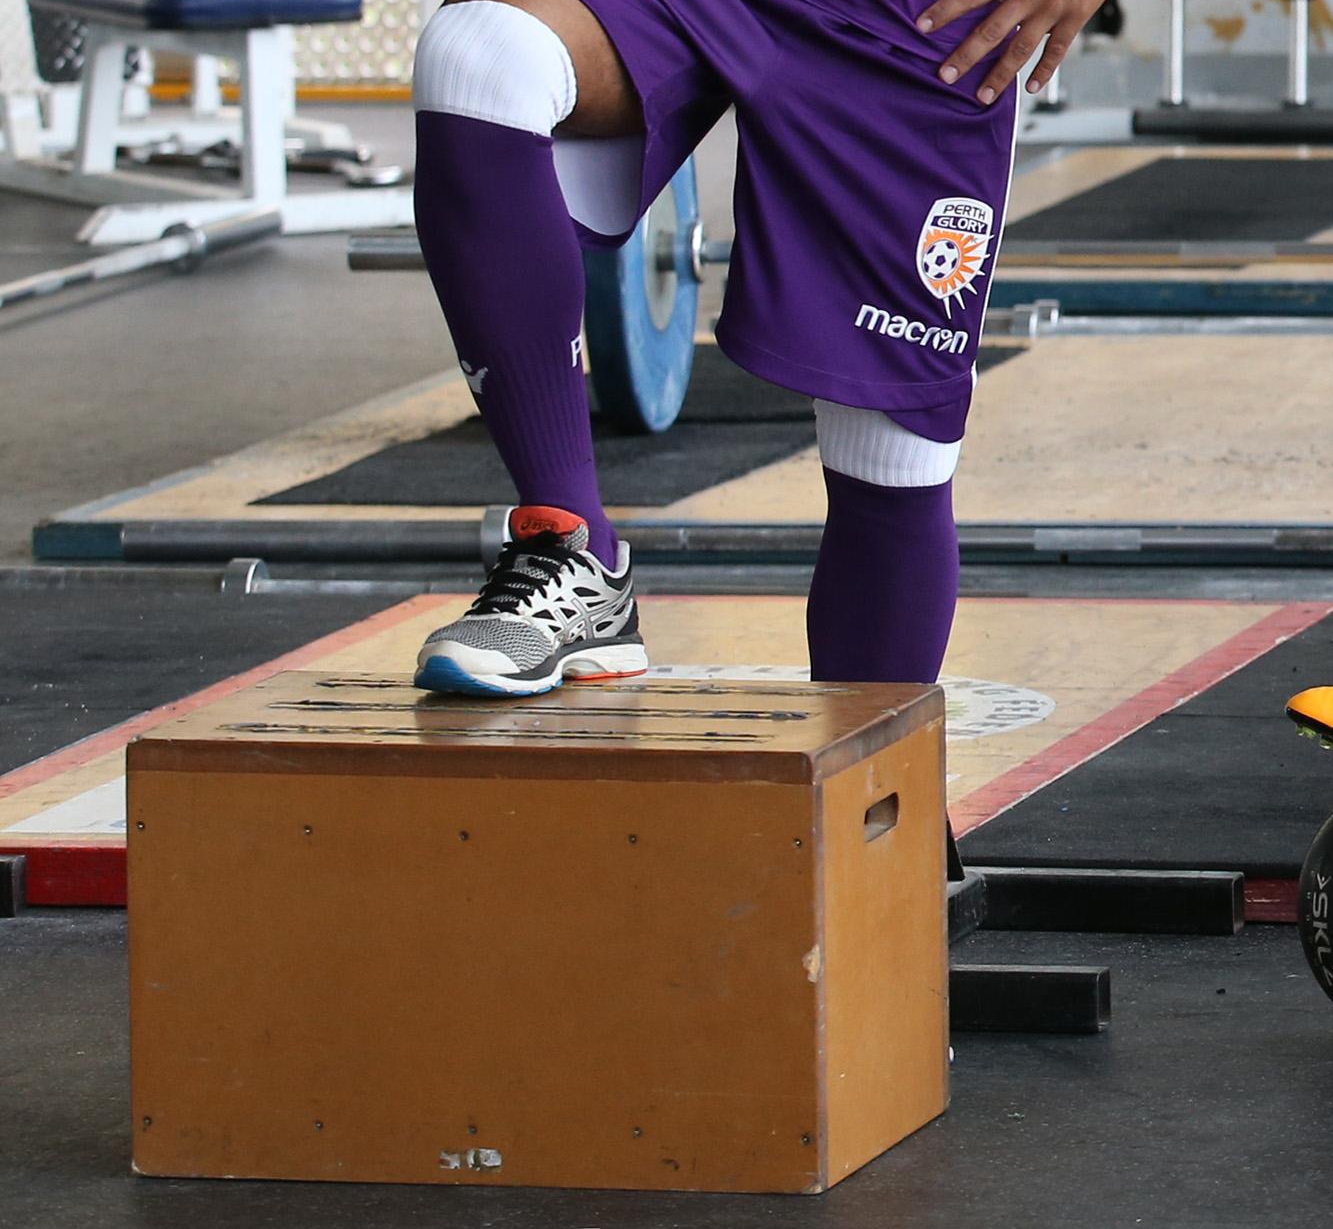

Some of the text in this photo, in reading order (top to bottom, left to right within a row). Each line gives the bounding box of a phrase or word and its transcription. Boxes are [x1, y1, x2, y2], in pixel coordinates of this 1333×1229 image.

[943, 204, 987, 220] PERTH
[937, 216, 987, 233] GLORY
[854, 304, 969, 355] macron
